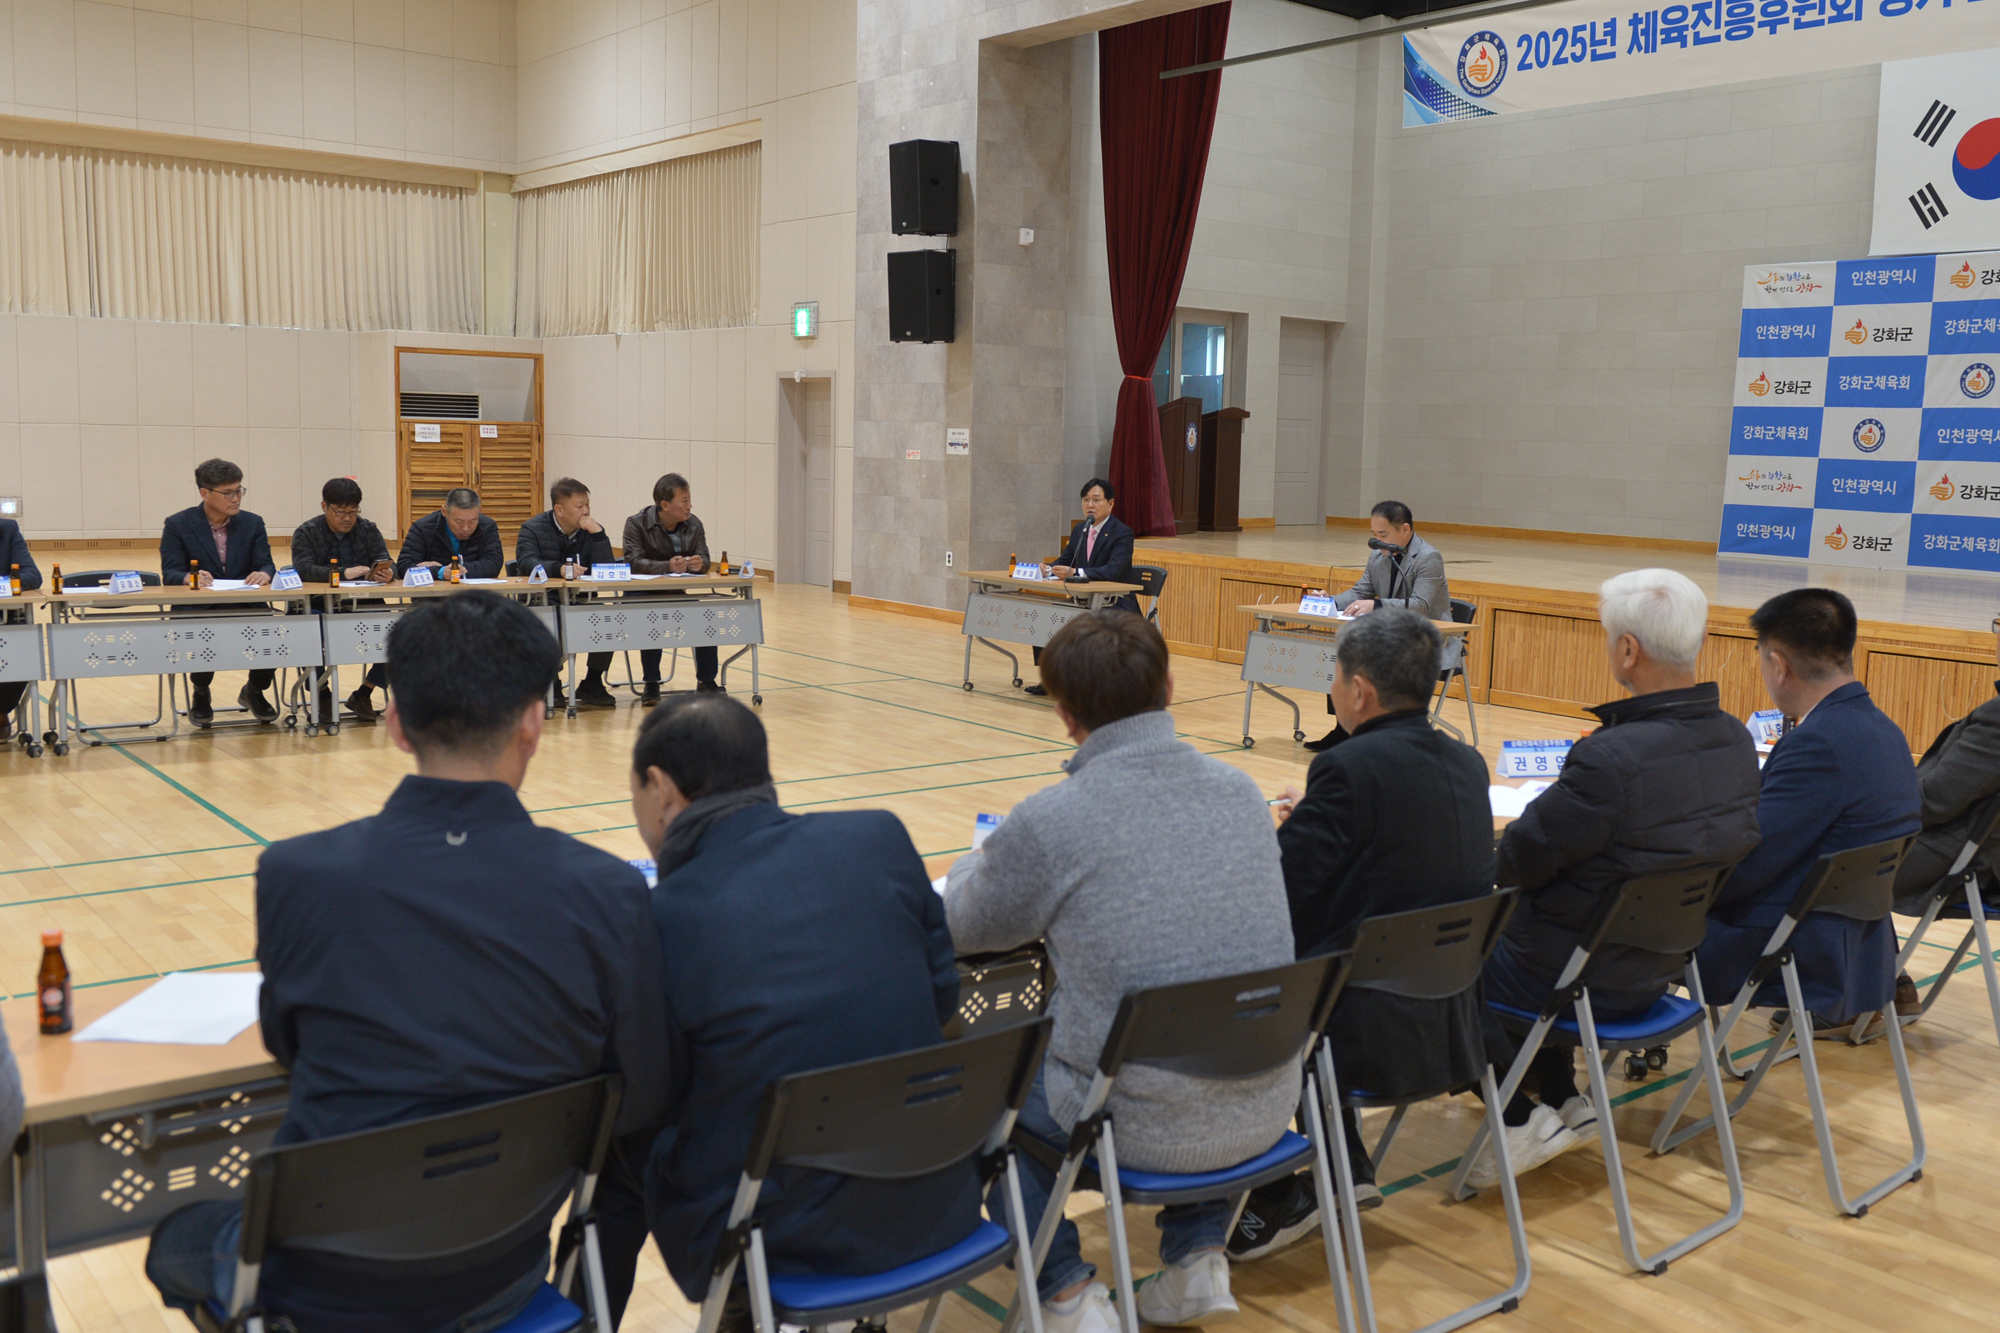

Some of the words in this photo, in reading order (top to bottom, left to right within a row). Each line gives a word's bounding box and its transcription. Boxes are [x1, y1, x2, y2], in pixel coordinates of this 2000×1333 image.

[1517, 17, 1617, 72] 2025년
[1481, 83, 1496, 94] Sports
[1851, 268, 1916, 286] 인천광역시
[1756, 324, 1816, 339] 인천광역시
[1872, 326, 1913, 343] 강화군
[1944, 318, 2000, 335] 강화군체
[1773, 380, 1812, 395] 강화군
[1838, 375, 1910, 391] 강화군체육회
[1743, 425, 1809, 441] 강화군체육회
[1832, 477, 1897, 496] 인천광역시
[1736, 523, 1796, 540] 인천광역시
[1852, 535, 1893, 552] 강화군
[1923, 534, 2000, 554] 강화군체육회
